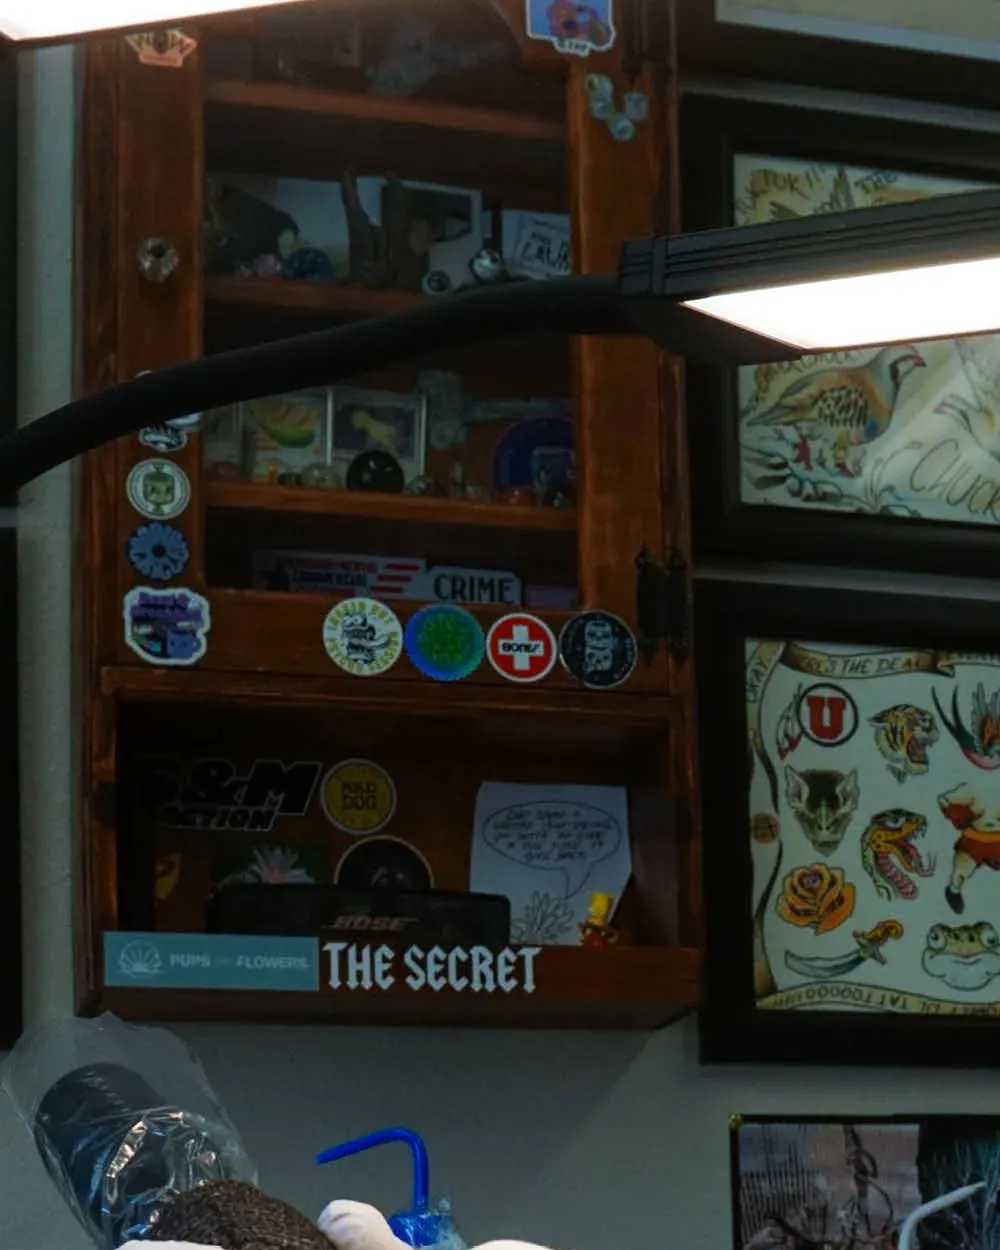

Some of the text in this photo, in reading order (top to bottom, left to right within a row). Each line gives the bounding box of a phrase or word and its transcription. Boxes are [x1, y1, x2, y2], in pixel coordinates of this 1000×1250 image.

[433, 573, 515, 604] CRIME
[840, 658, 872, 674] THE
[806, 695, 846, 740] U
[322, 941, 542, 995] THE SECRET
